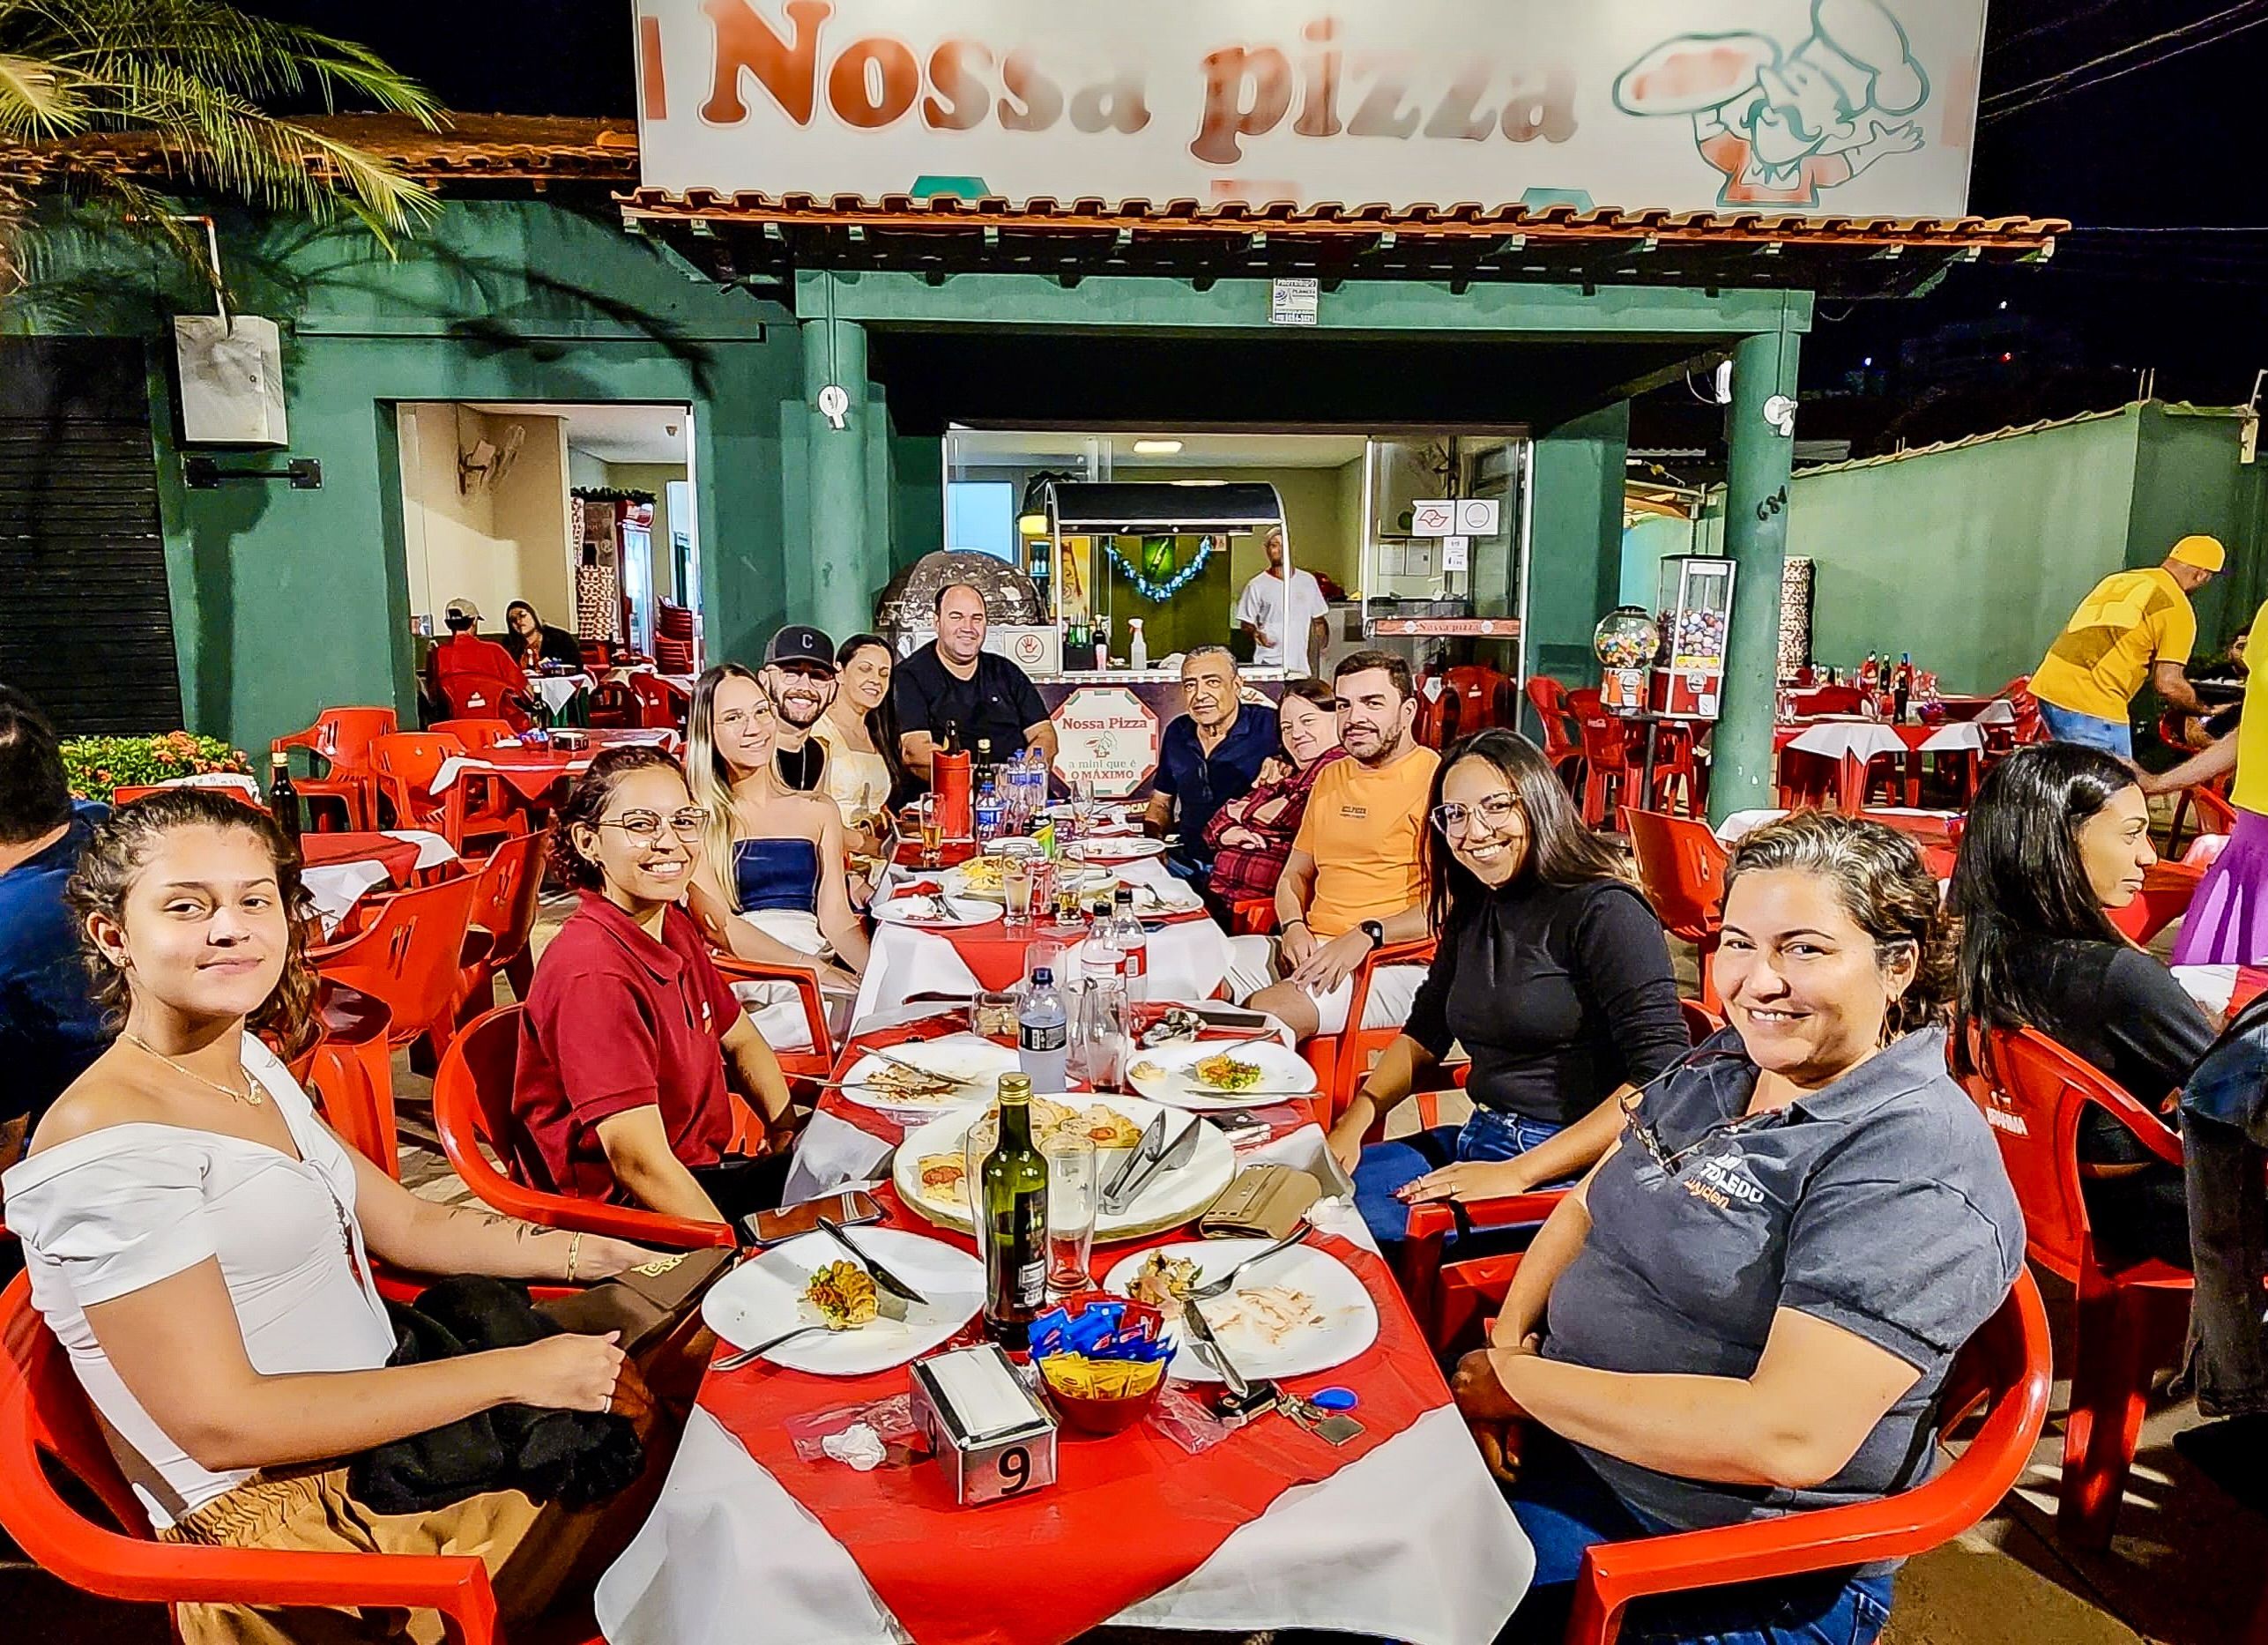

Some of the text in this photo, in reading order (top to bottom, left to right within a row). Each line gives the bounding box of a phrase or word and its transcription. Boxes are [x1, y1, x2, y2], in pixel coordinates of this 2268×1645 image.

[698, 0, 1579, 165] Nossa pizza
[1756, 485, 1788, 521] 684
[803, 634, 813, 648] C
[1062, 717, 1148, 730] Nossa Pizza
[1068, 759, 1137, 771] a mini que é
[1699, 1162, 1766, 1203] TOLEDO
[998, 1446, 1030, 1495] 9
